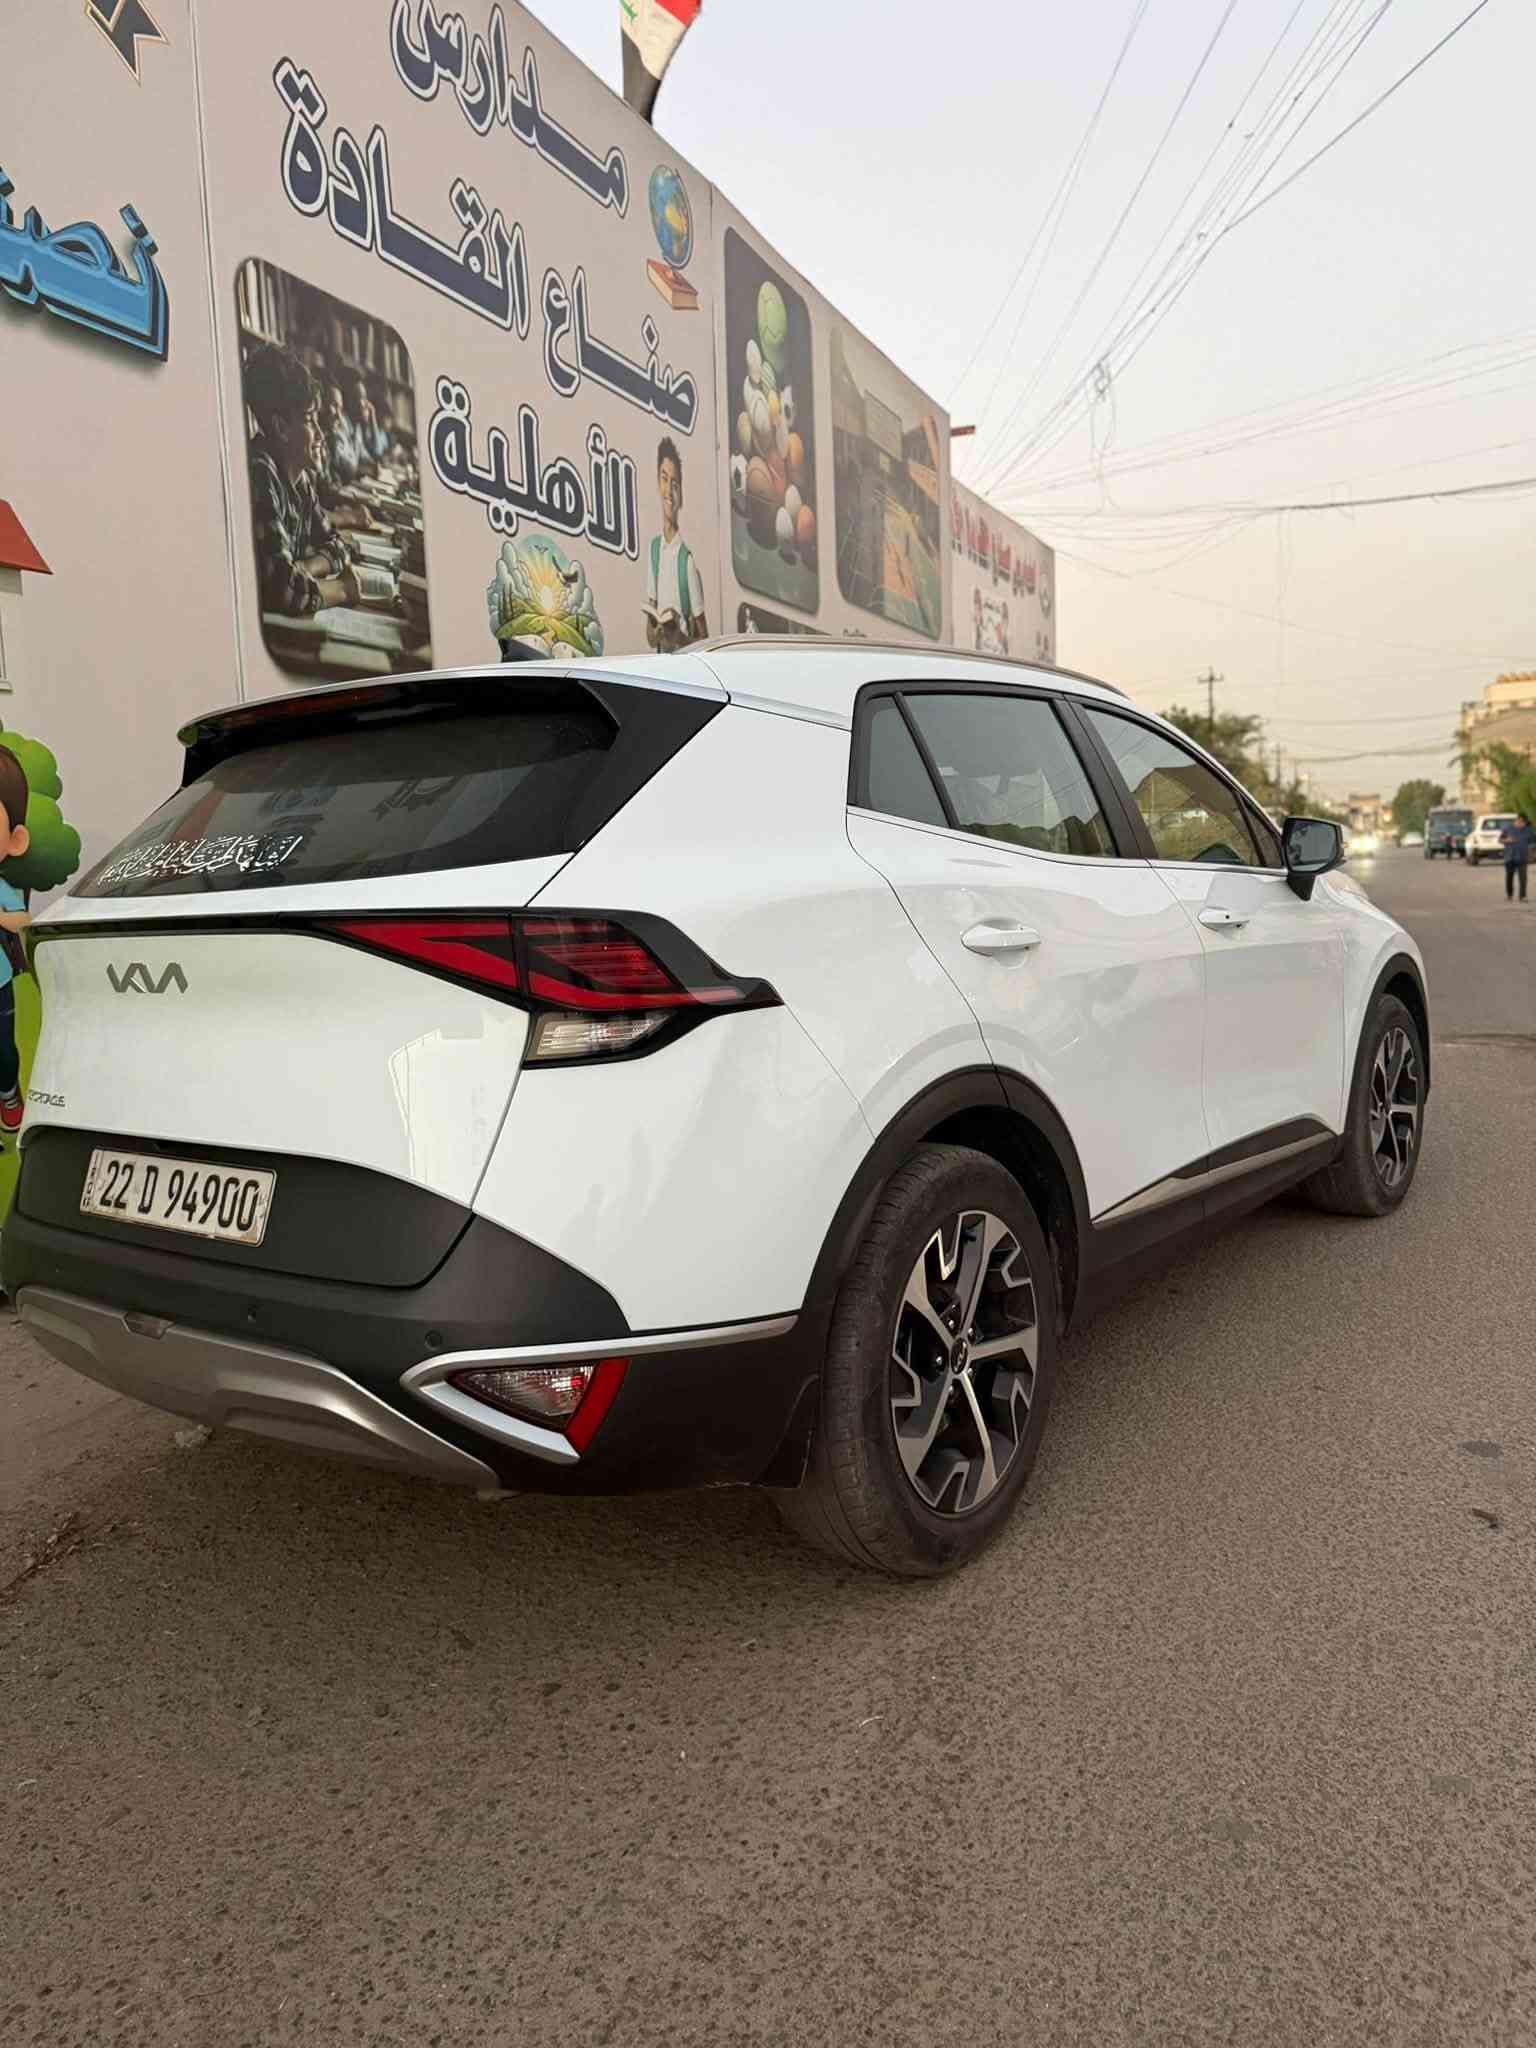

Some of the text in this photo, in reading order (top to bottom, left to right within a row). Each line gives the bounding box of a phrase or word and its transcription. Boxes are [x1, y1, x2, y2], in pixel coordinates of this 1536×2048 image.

[391, 0, 627, 217] مدارس
[273, 56, 699, 435] صناع القادة
[429, 376, 639, 559] الأهلية
[106, 962, 188, 993] KIA
[100, 1160, 260, 1231] 22 D 94900
